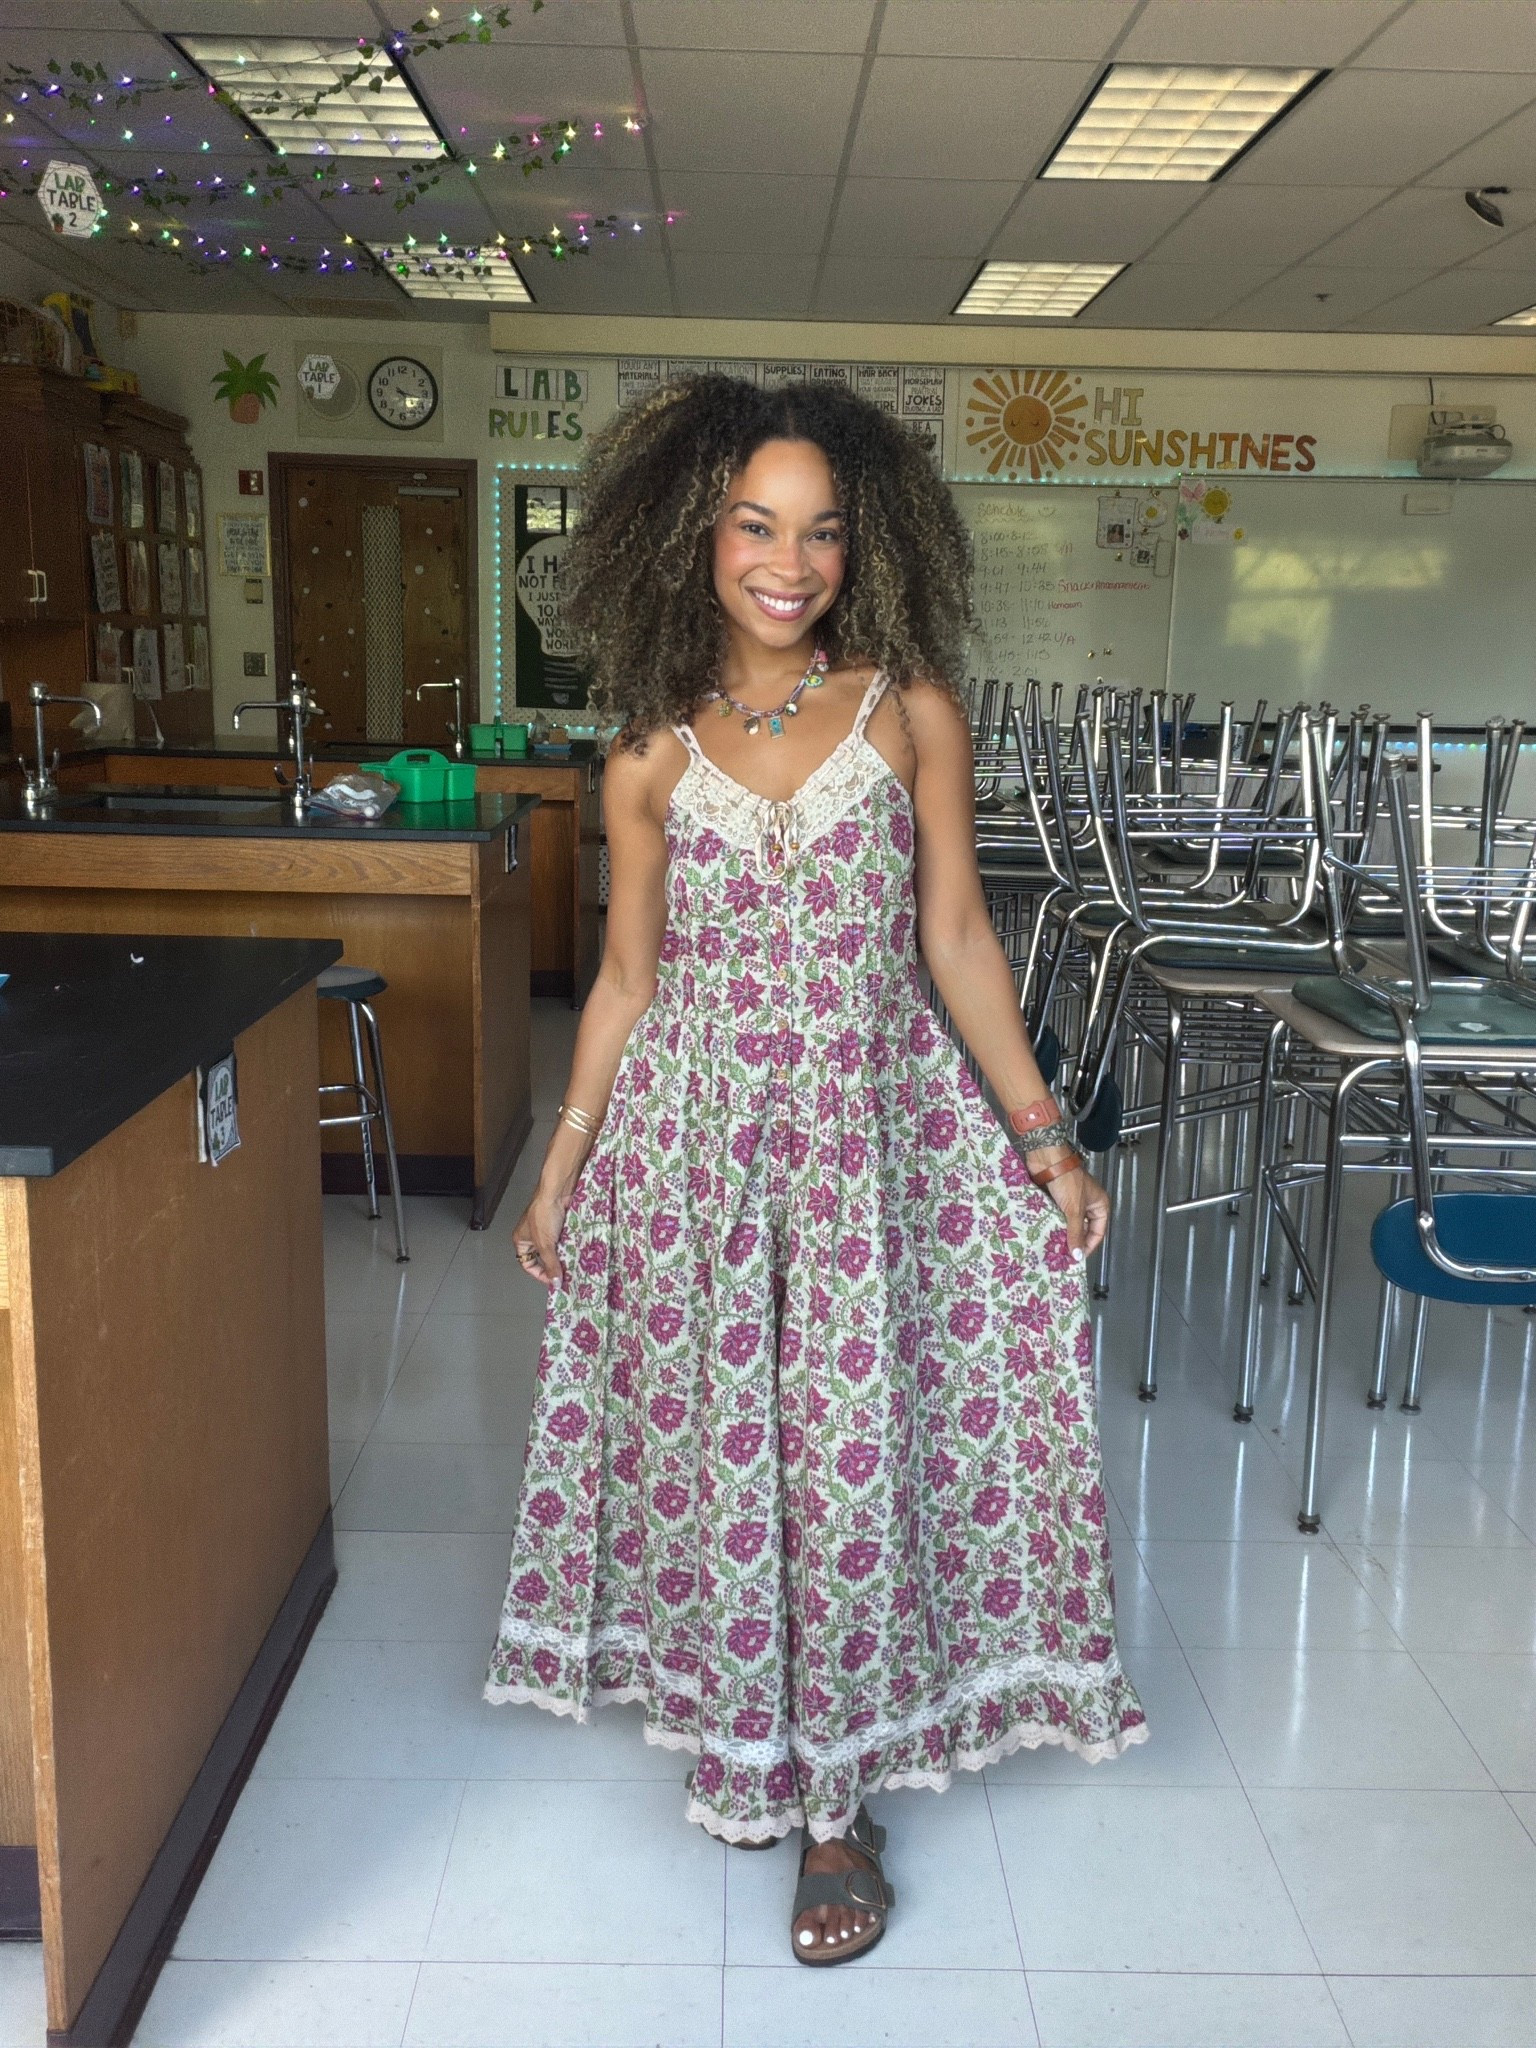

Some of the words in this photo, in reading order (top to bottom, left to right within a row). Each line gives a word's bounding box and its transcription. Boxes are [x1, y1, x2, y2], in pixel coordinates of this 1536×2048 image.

[54, 172, 86, 193] LAB
[47, 189, 96, 212] TABLE
[69, 212, 77, 227] 2
[308, 361, 329, 372] LAB
[398, 366, 407, 374] 12
[303, 372, 335, 383] TABLE
[388, 368, 395, 377] 11
[619, 372, 659, 380] MATERIALS
[859, 369, 876, 377] HAIR
[878, 369, 897, 377] BACK
[379, 378, 389, 386] 10
[419, 379, 425, 387] 2
[504, 368, 581, 401] LAB
[376, 388, 383, 397] 9
[381, 400, 387, 408] 8
[906, 395, 942, 405] JOKES
[874, 400, 896, 412] FIRE
[1094, 387, 1144, 426] HI
[399, 413, 406, 421] 6
[489, 408, 583, 441] RULES
[912, 422, 923, 433] BE
[1084, 429, 1317, 472] SUNSHINES
[526, 555, 535, 573] I
[519, 575, 547, 589] NOT
[528, 592, 533, 601] I
[536, 591, 561, 602] JUST
[210, 1096, 232, 1130] TABLE
